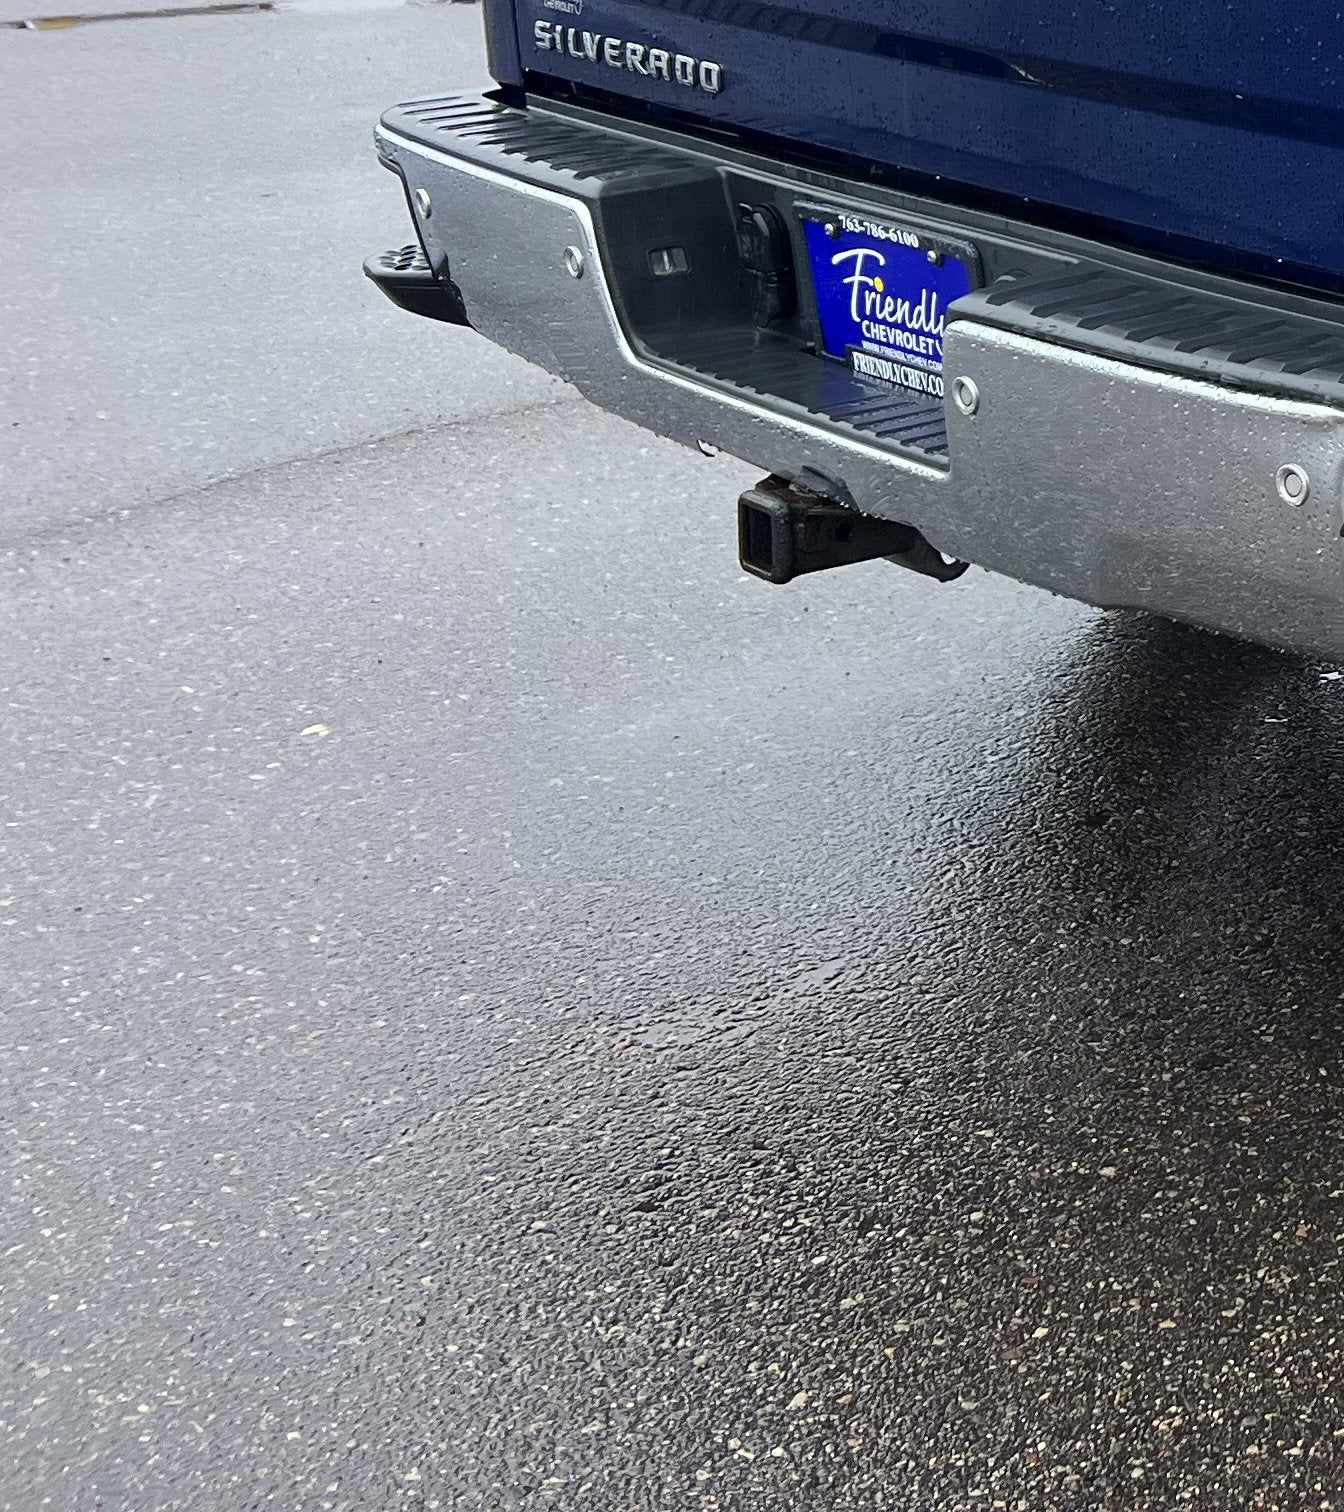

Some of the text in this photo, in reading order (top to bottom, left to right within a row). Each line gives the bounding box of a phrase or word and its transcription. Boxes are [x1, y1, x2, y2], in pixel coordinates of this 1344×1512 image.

[534, 20, 723, 94] SILVERADO
[837, 215, 919, 248] 763-786-6100
[862, 319, 935, 356] CHEVROLET
[852, 351, 944, 397] FRIENDLYCHEV.CO
